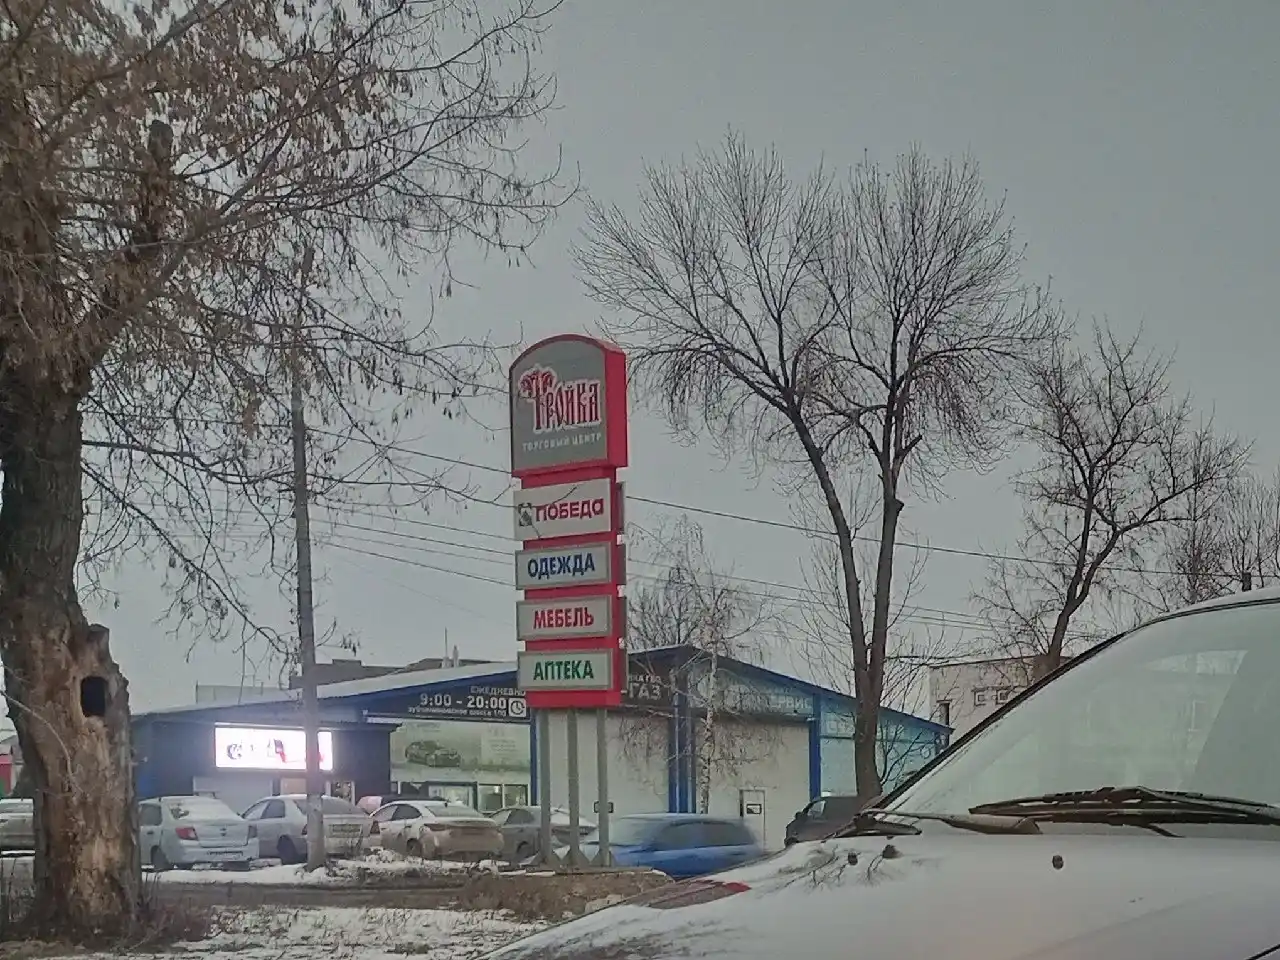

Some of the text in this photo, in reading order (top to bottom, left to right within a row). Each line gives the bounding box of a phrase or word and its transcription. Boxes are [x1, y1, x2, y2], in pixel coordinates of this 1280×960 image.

[522, 432, 602, 452] ТОРГОВЫЙ ЦЕНТР
[527, 553, 595, 580] ОДЕЖДА
[533, 607, 594, 629] МЕБЕЛЬ
[533, 660, 594, 681] АПТЕКА
[420, 693, 452, 706] 9:00
[467, 695, 507, 709] 20:00
